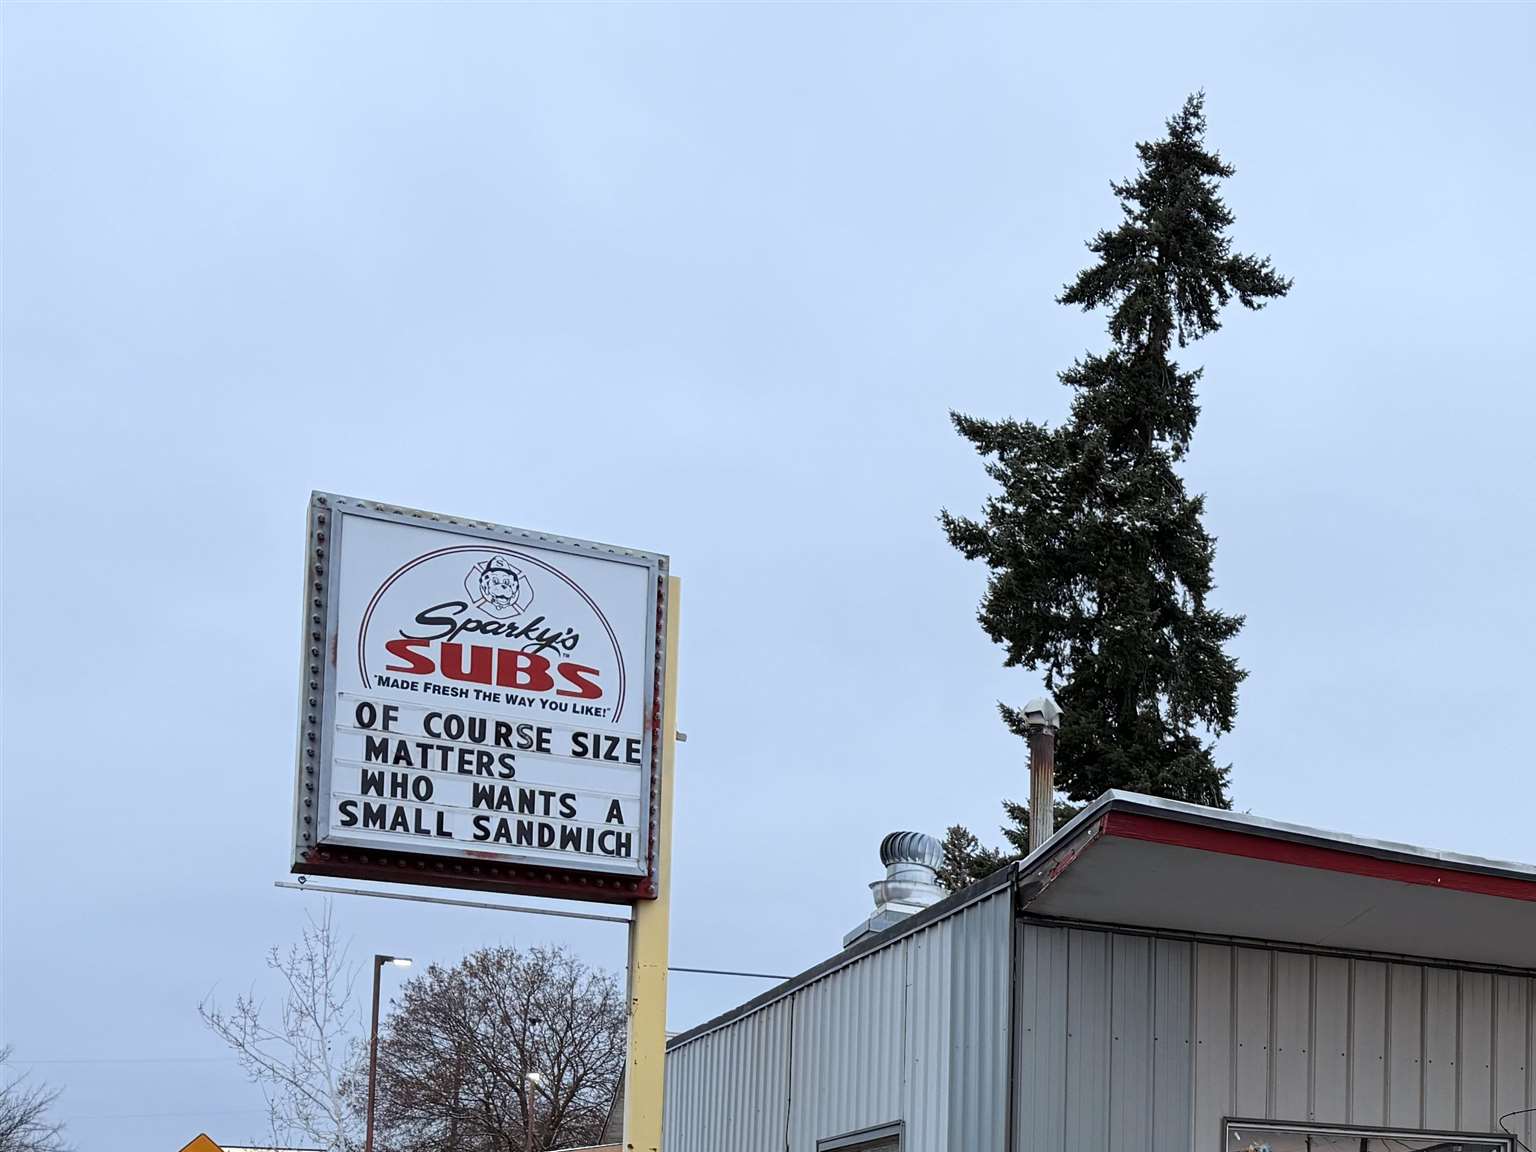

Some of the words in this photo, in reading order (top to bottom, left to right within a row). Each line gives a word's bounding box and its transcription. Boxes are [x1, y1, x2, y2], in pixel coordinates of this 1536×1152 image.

[399, 601, 579, 657] Sparky's
[385, 638, 603, 700] SUBS
[423, 682, 469, 699] FRESH
[473, 689, 500, 703] THE
[505, 693, 536, 708] WAY
[539, 698, 569, 712] YOU
[355, 701, 399, 731] OF
[423, 711, 553, 754] COURSE
[571, 731, 641, 764] SIZE
[365, 735, 516, 779] MATTERS
[360, 768, 434, 802] WHO
[472, 782, 577, 819] WANTS
[605, 799, 624, 825] A
[338, 800, 453, 838] SMALL
[472, 815, 632, 857] SANDWICH
